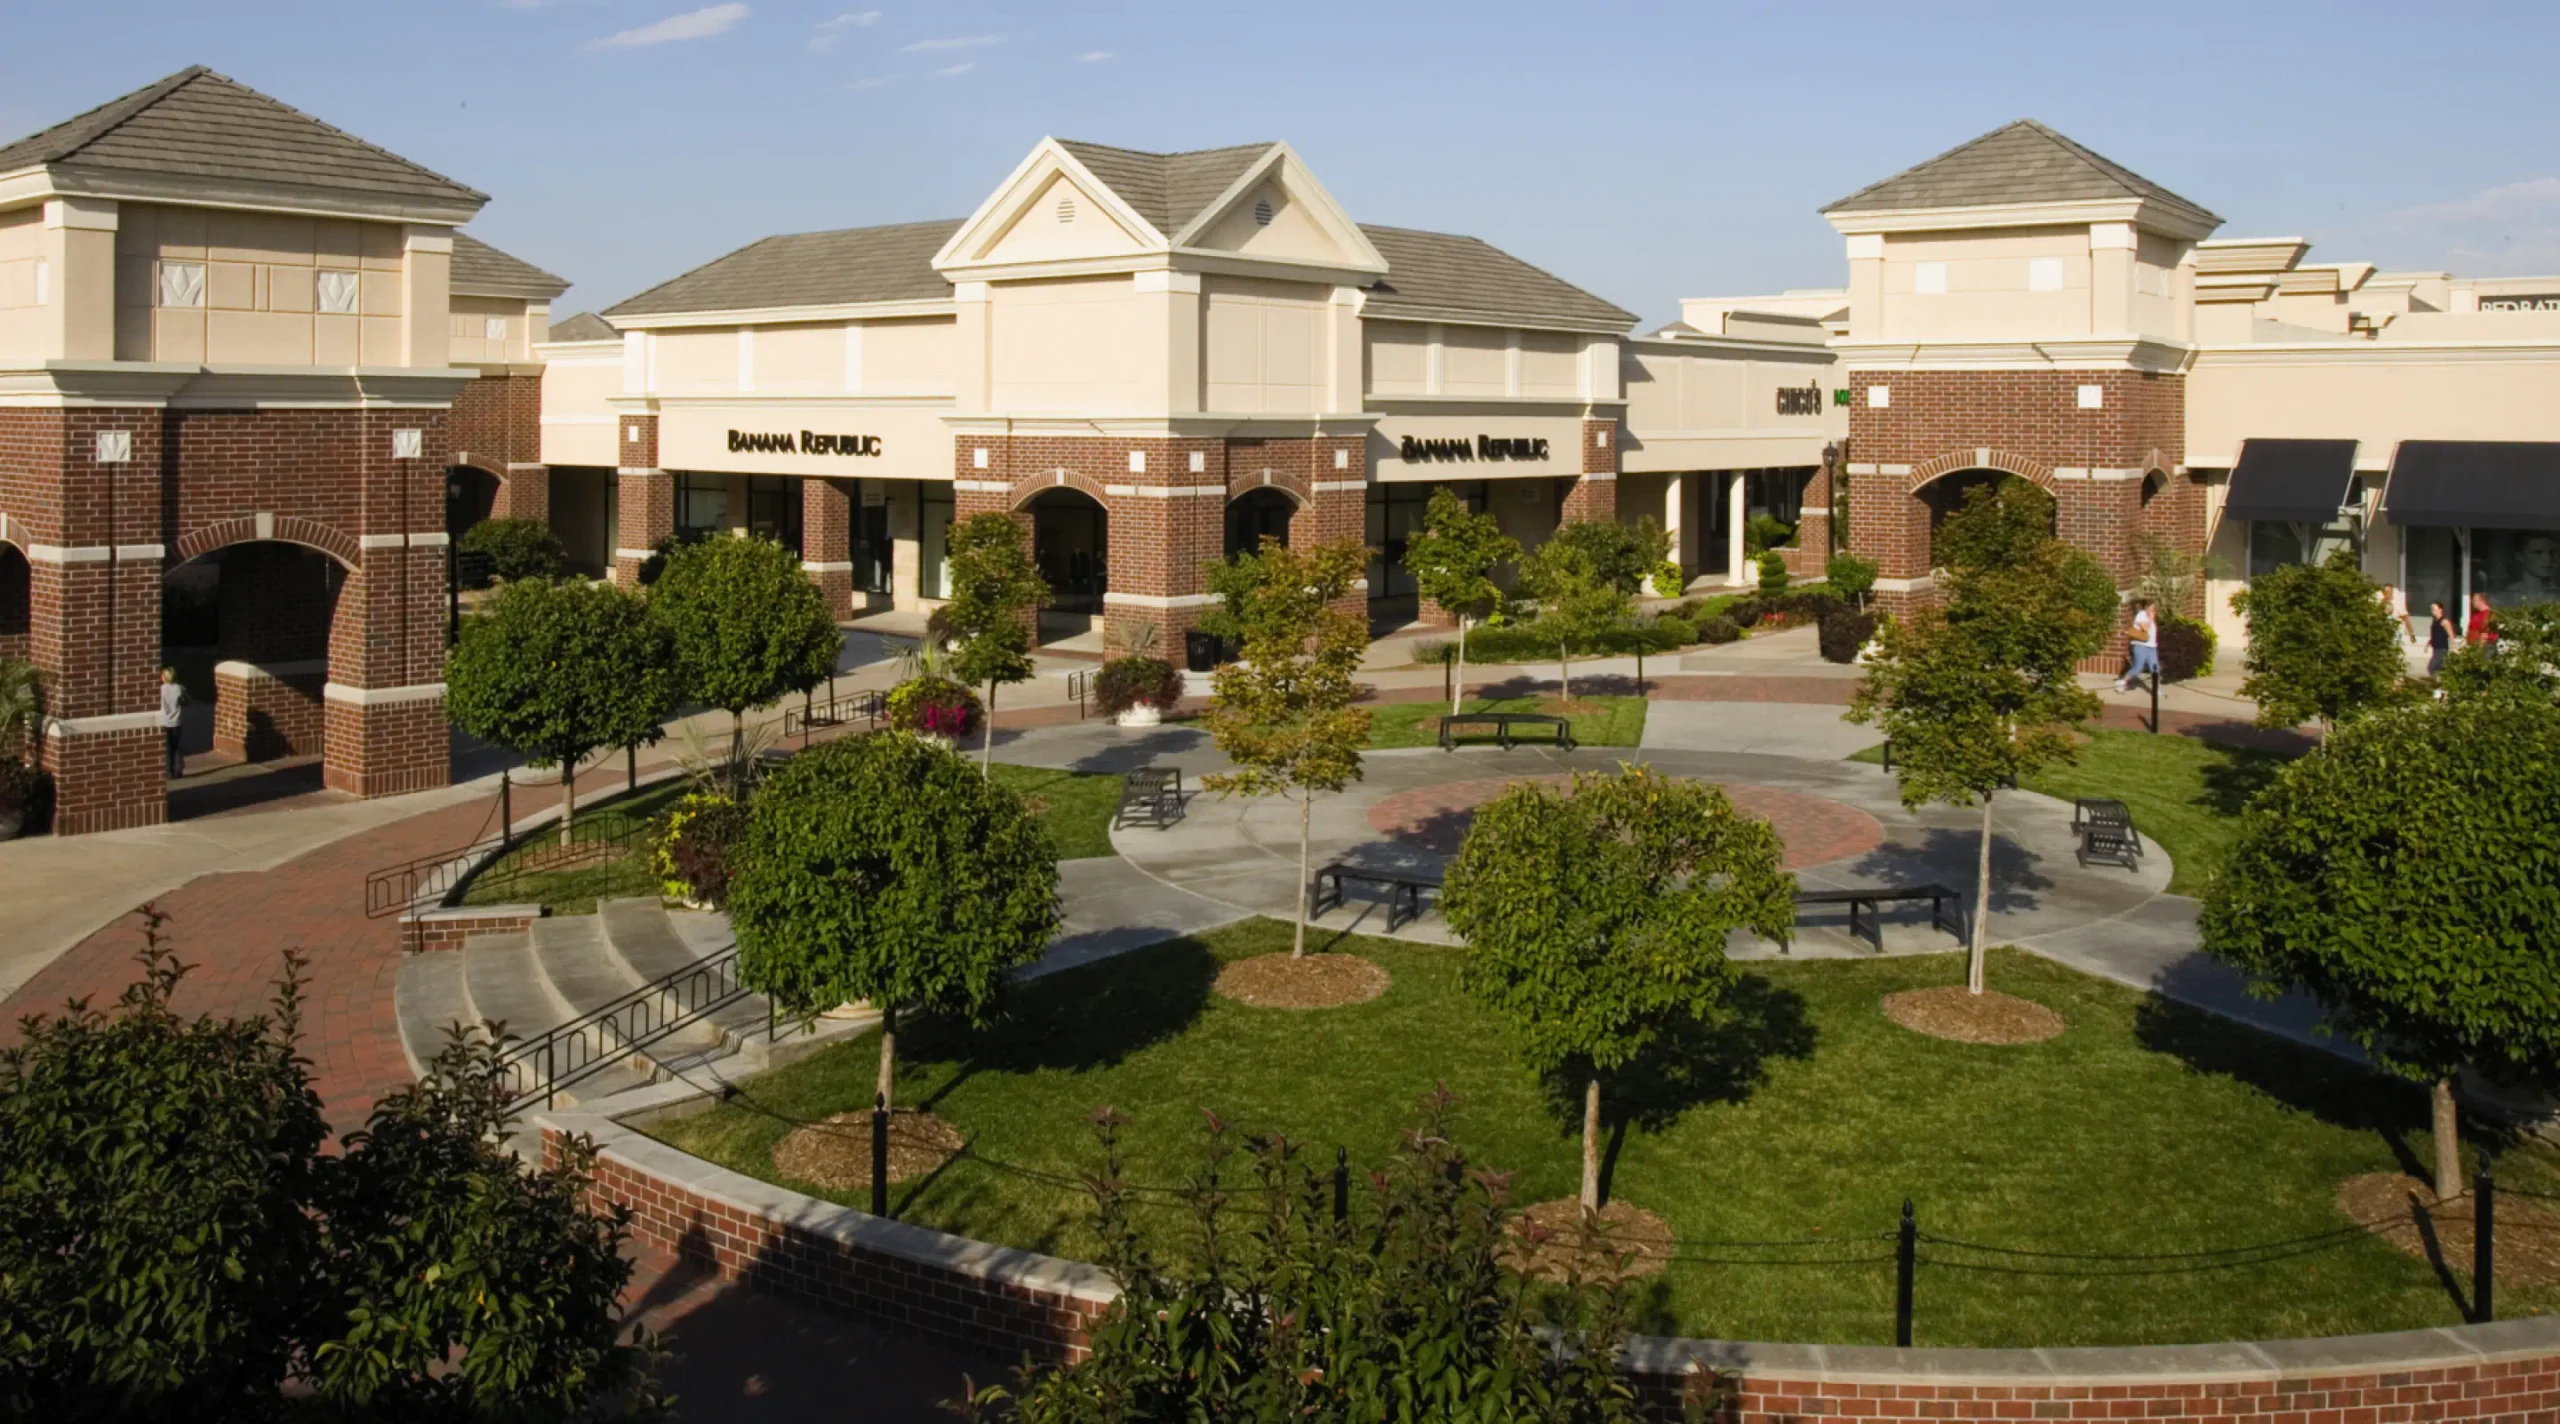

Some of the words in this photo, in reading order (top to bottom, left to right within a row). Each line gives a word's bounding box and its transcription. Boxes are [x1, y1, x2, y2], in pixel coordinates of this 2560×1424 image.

[728, 429, 797, 454] BANANA
[801, 430, 882, 457] REPUBLIC
[1401, 434, 1475, 462] BANANA
[1478, 434, 1550, 461] REPUBLIC
